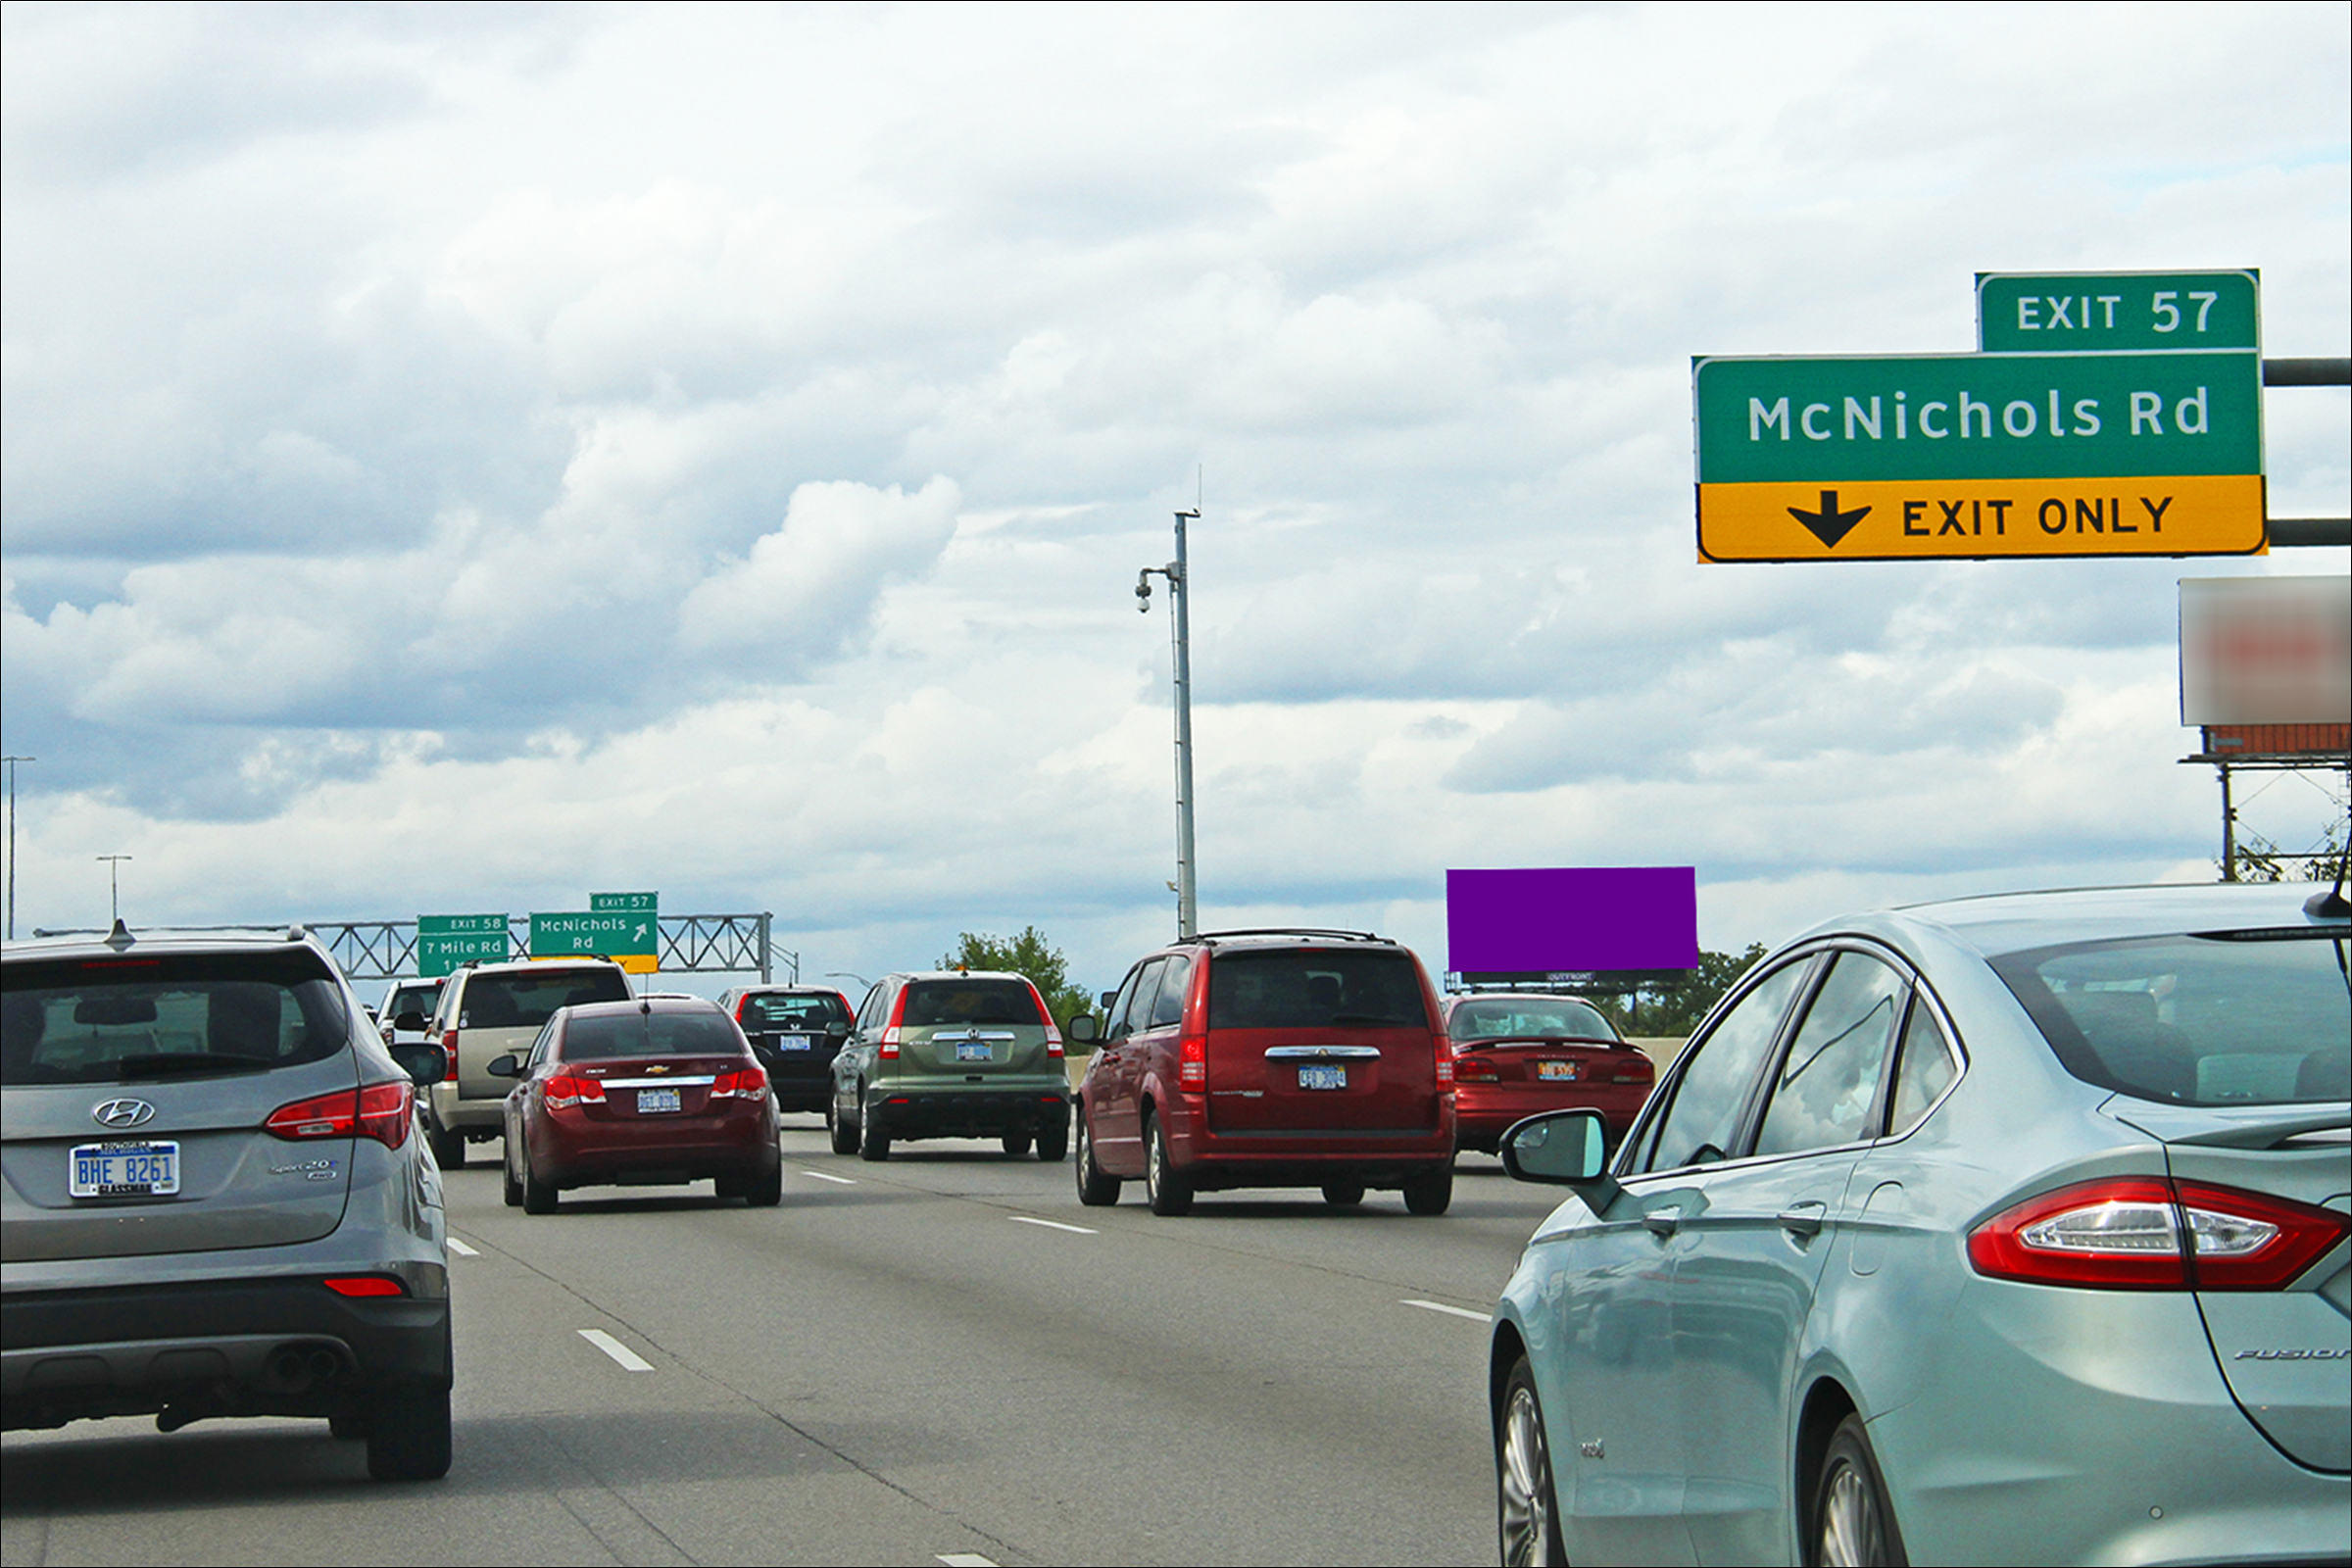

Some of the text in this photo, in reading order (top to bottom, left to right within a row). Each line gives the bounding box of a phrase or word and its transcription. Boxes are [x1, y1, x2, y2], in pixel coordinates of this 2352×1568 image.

[2017, 290, 2219, 332] EXIT 57
[1748, 386, 2210, 441] McNichols Rd
[1902, 496, 2174, 536] EXIT ONLY
[599, 896, 649, 907] EXIT 57
[451, 918, 502, 929] EXIT 58
[540, 918, 627, 932] McNichols
[426, 941, 502, 955] 7 Mile Rd
[573, 937, 594, 949] Rd
[444, 960, 450, 970] 1
[78, 1155, 173, 1185] BHE 8261
